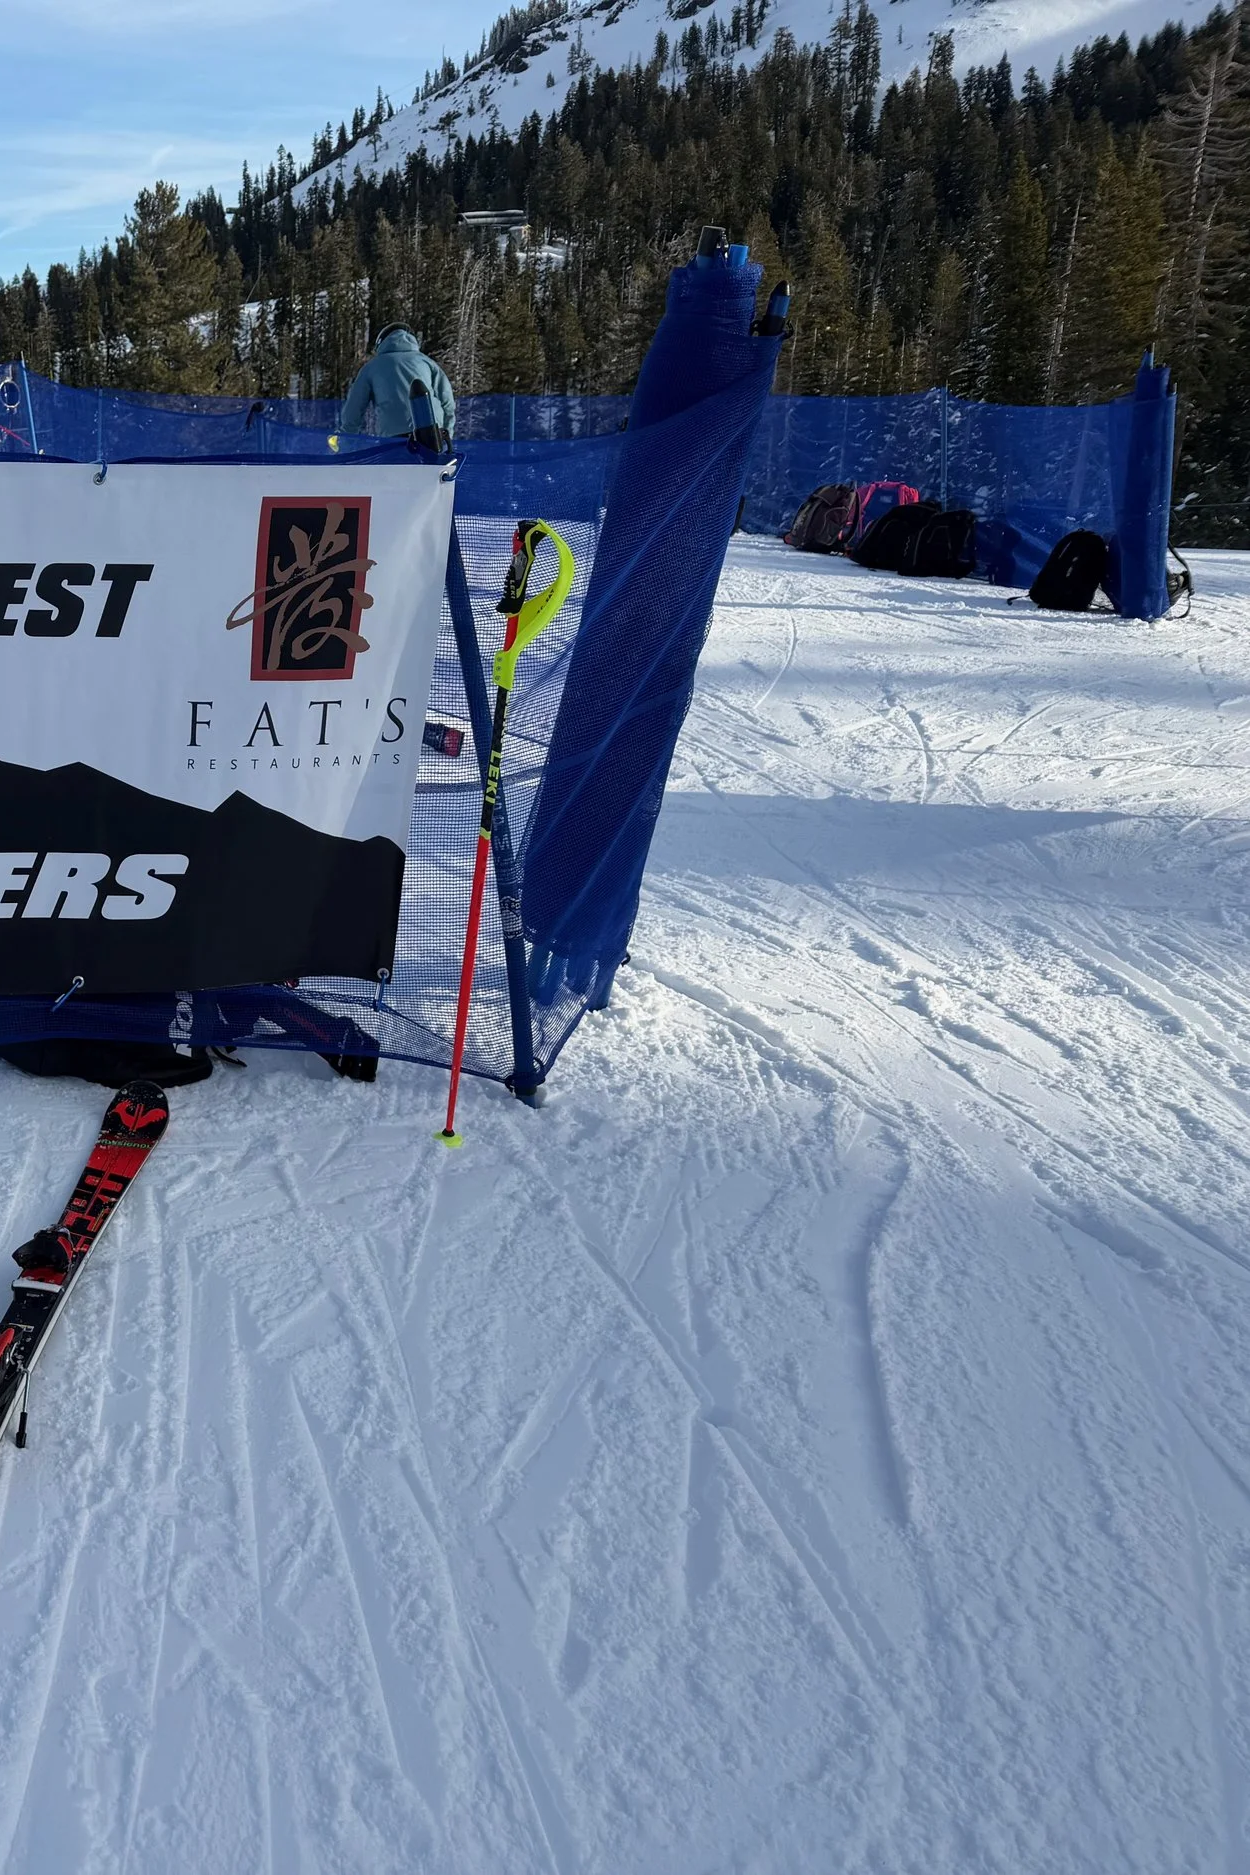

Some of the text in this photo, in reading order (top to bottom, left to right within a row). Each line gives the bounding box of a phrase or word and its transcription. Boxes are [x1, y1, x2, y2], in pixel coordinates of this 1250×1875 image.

[187, 697, 407, 747] FAT'S
[187, 754, 401, 770] RESTAURANTS
[485, 750, 501, 804] LEKI
